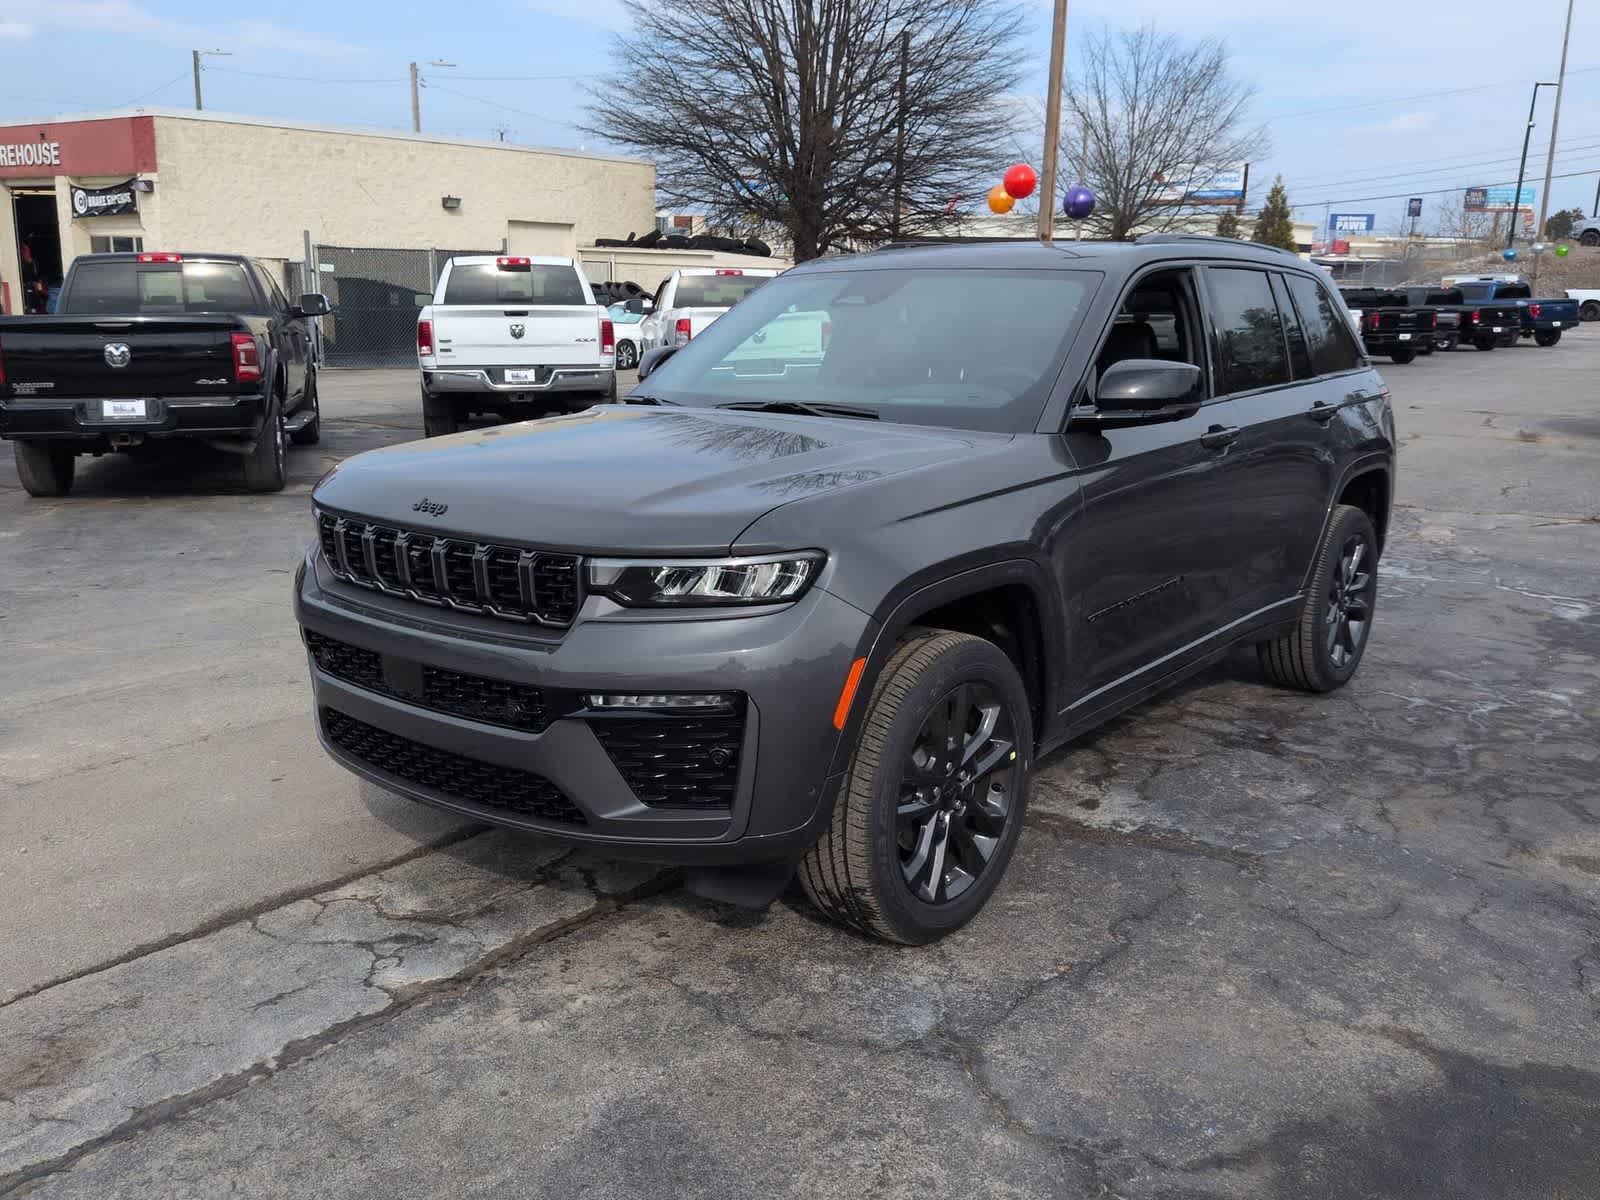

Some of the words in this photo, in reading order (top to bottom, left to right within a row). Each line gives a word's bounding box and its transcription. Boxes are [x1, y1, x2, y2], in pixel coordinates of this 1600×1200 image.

[0, 142, 61, 166] REHOUSE
[1335, 219, 1368, 231] PAWN
[412, 498, 448, 517] Jeep
